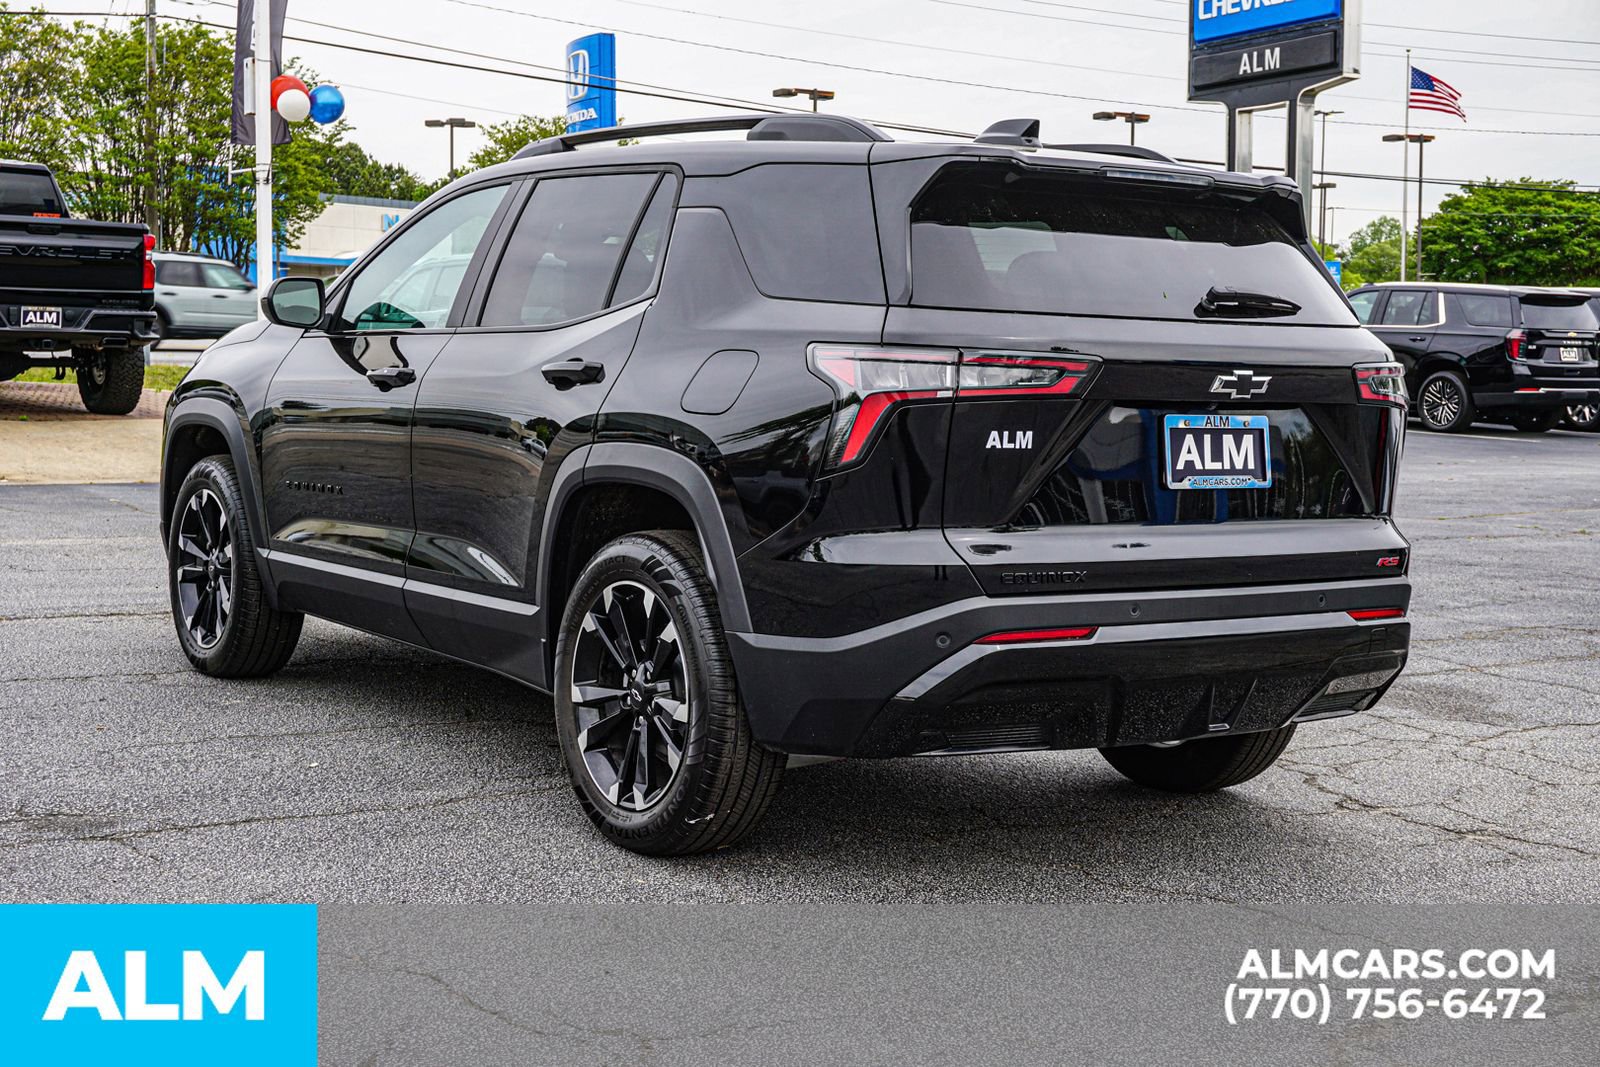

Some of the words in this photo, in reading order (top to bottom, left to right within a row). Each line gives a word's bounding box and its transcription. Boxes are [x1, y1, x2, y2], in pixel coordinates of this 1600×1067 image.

[1238, 47, 1281, 75] ALM
[25, 311, 57, 323] ALM
[1204, 416, 1230, 428] ALM
[985, 430, 1034, 449] ALM
[1176, 433, 1255, 470] ALM
[285, 480, 344, 495] EQUINOX
[1192, 478, 1248, 486] ALMCARS.COM
[1376, 556, 1399, 567] RS
[1001, 571, 1088, 584] EQUINOX
